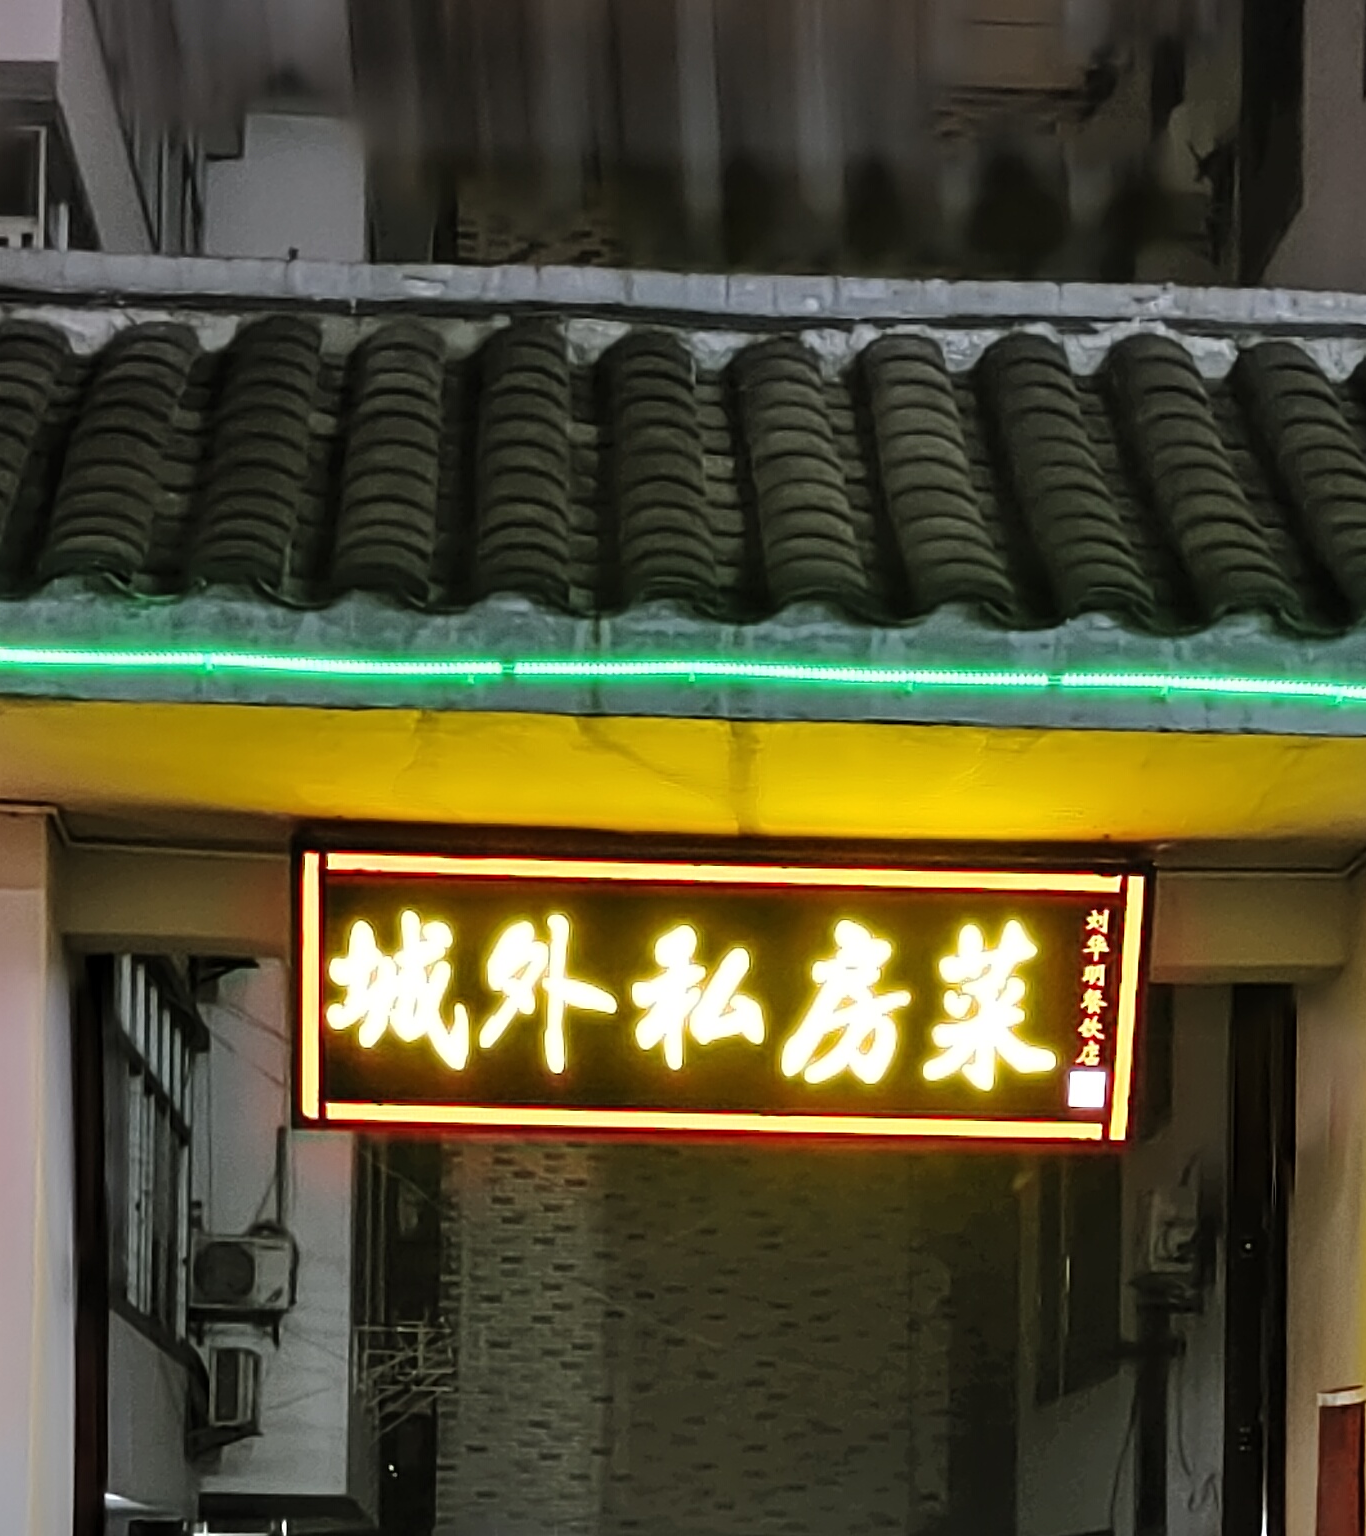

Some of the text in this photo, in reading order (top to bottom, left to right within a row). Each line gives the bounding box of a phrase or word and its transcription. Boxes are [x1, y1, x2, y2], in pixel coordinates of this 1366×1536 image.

[327, 908, 1058, 1091] 城外私房菜
